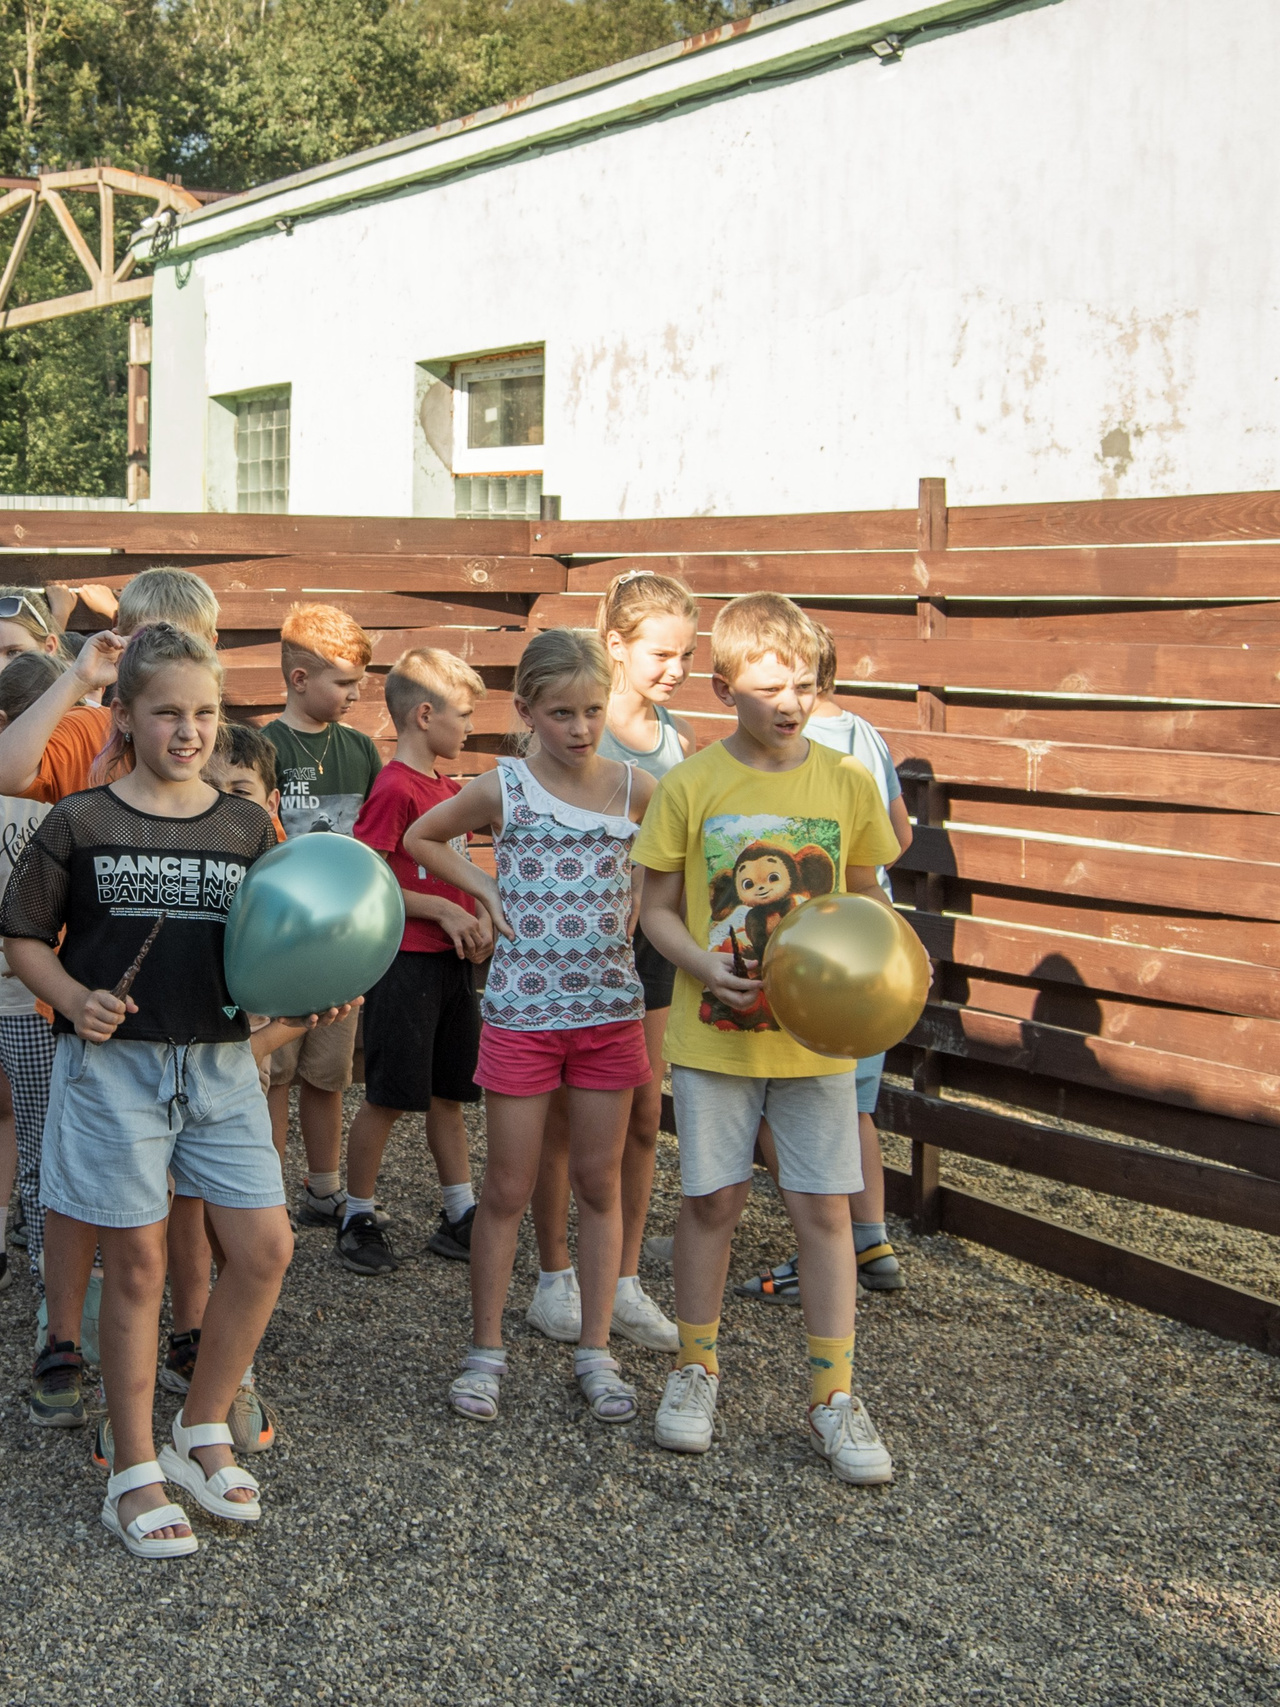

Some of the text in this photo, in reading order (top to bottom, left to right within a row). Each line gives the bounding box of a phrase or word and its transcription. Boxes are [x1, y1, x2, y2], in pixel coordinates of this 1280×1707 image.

[283, 766, 317, 781] TAKE
[283, 781, 310, 795] THE
[280, 795, 320, 810] WILD
[94, 855, 201, 878] DANCE
[96, 871, 201, 891] DANCE
[98, 885, 200, 906] DANCE
